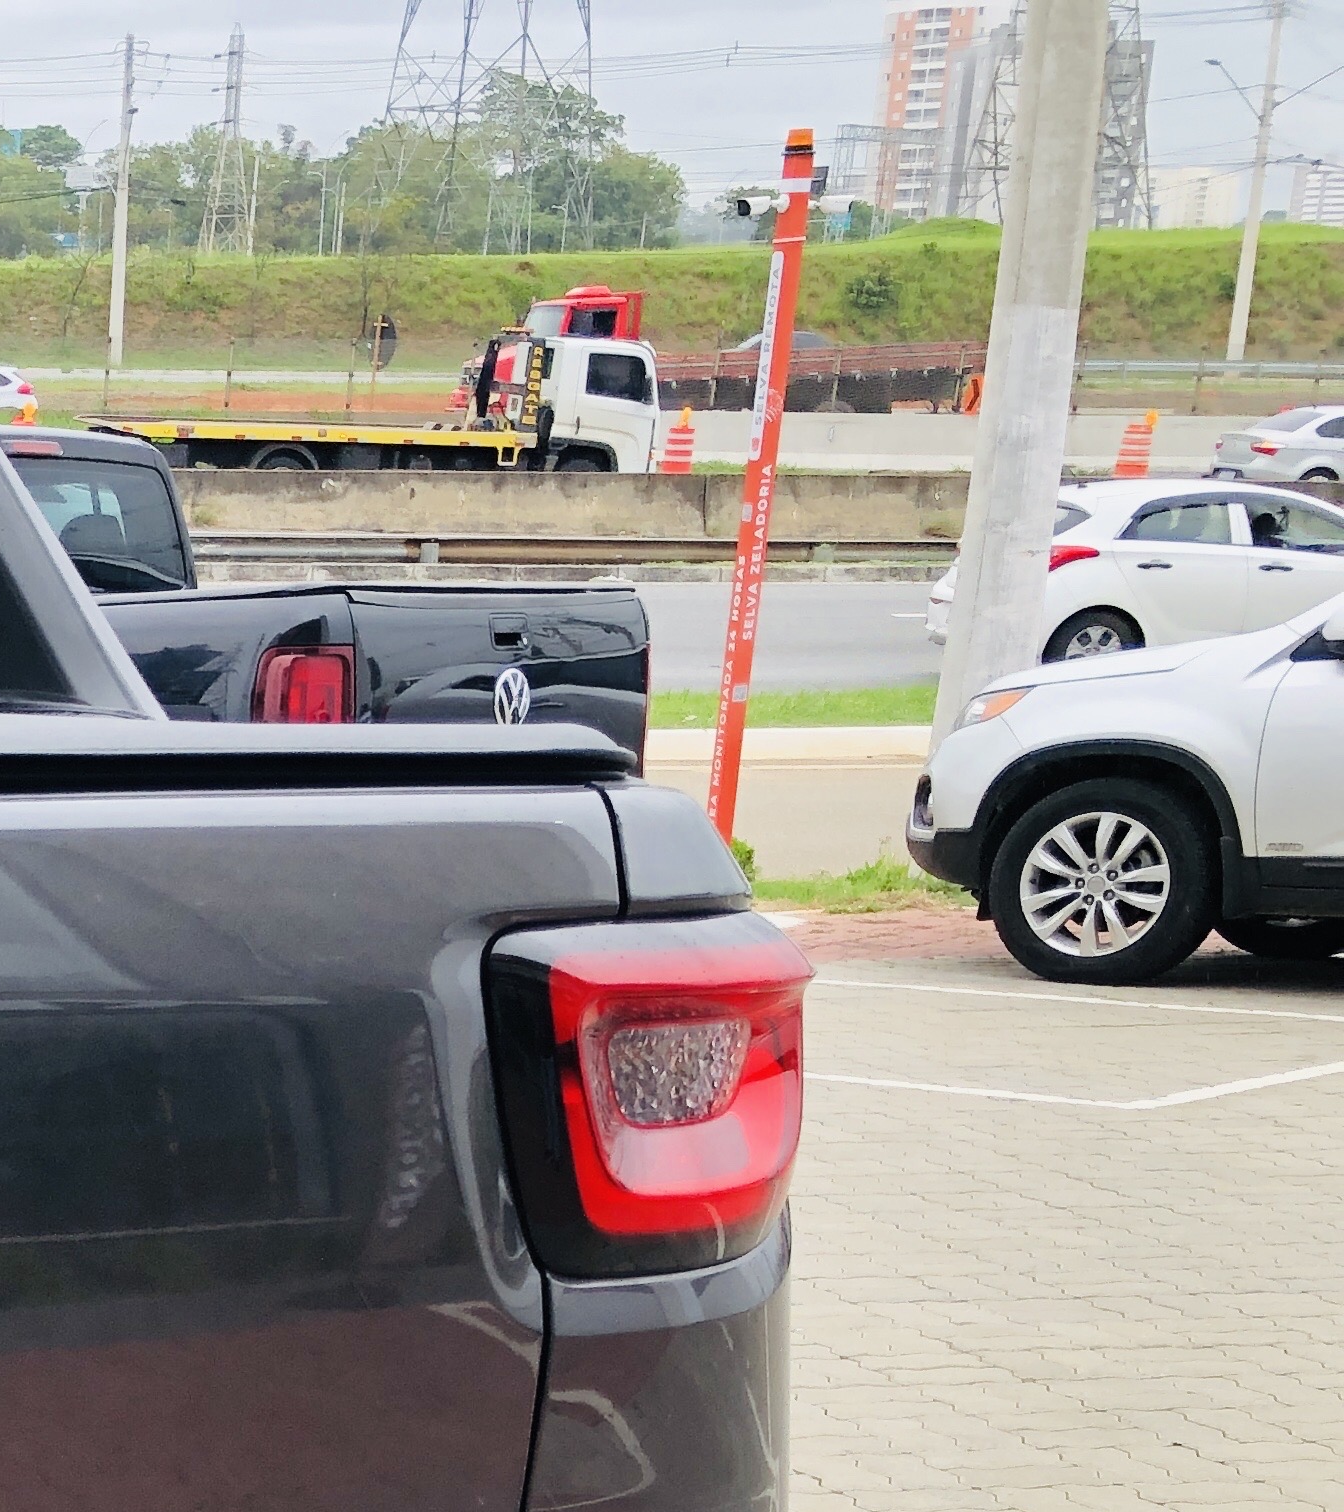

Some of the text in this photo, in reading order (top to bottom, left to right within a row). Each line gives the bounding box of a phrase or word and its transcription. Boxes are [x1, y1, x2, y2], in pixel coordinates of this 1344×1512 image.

[755, 363, 769, 425] SELVA
[763, 267, 781, 352] REMOTA
[750, 464, 772, 574] ZELADORIA
[712, 660, 733, 786] MONITORADA
[727, 629, 737, 652] 24
[732, 555, 746, 621] HORAS
[743, 582, 758, 641] SELVA
